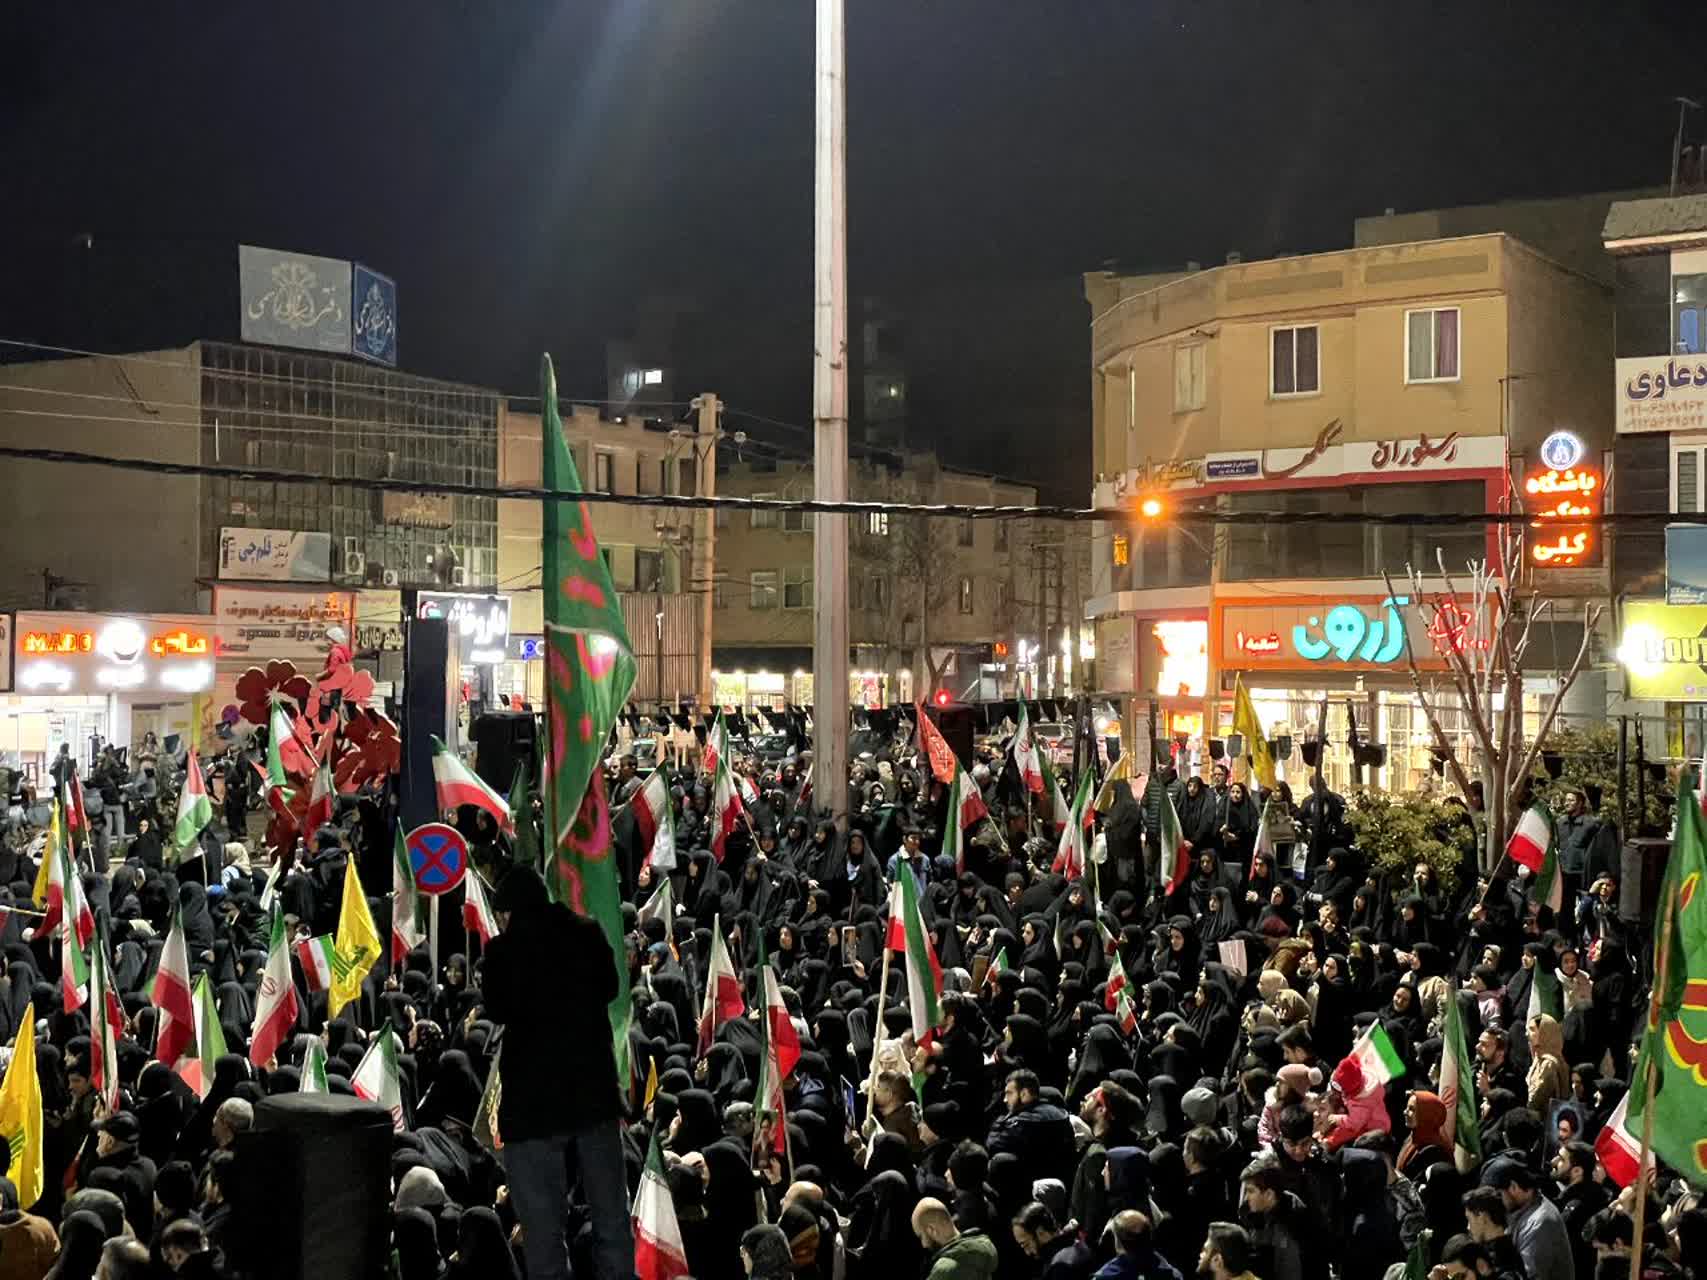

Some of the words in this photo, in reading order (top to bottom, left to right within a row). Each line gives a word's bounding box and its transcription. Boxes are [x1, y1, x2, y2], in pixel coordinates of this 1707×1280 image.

[1626, 359, 1707, 400] دعاوی
[1372, 431, 1463, 469] رستوران
[1526, 469, 1596, 496] باشگاه
[23, 631, 94, 653] MADO
[1246, 632, 1281, 657] شعبه
